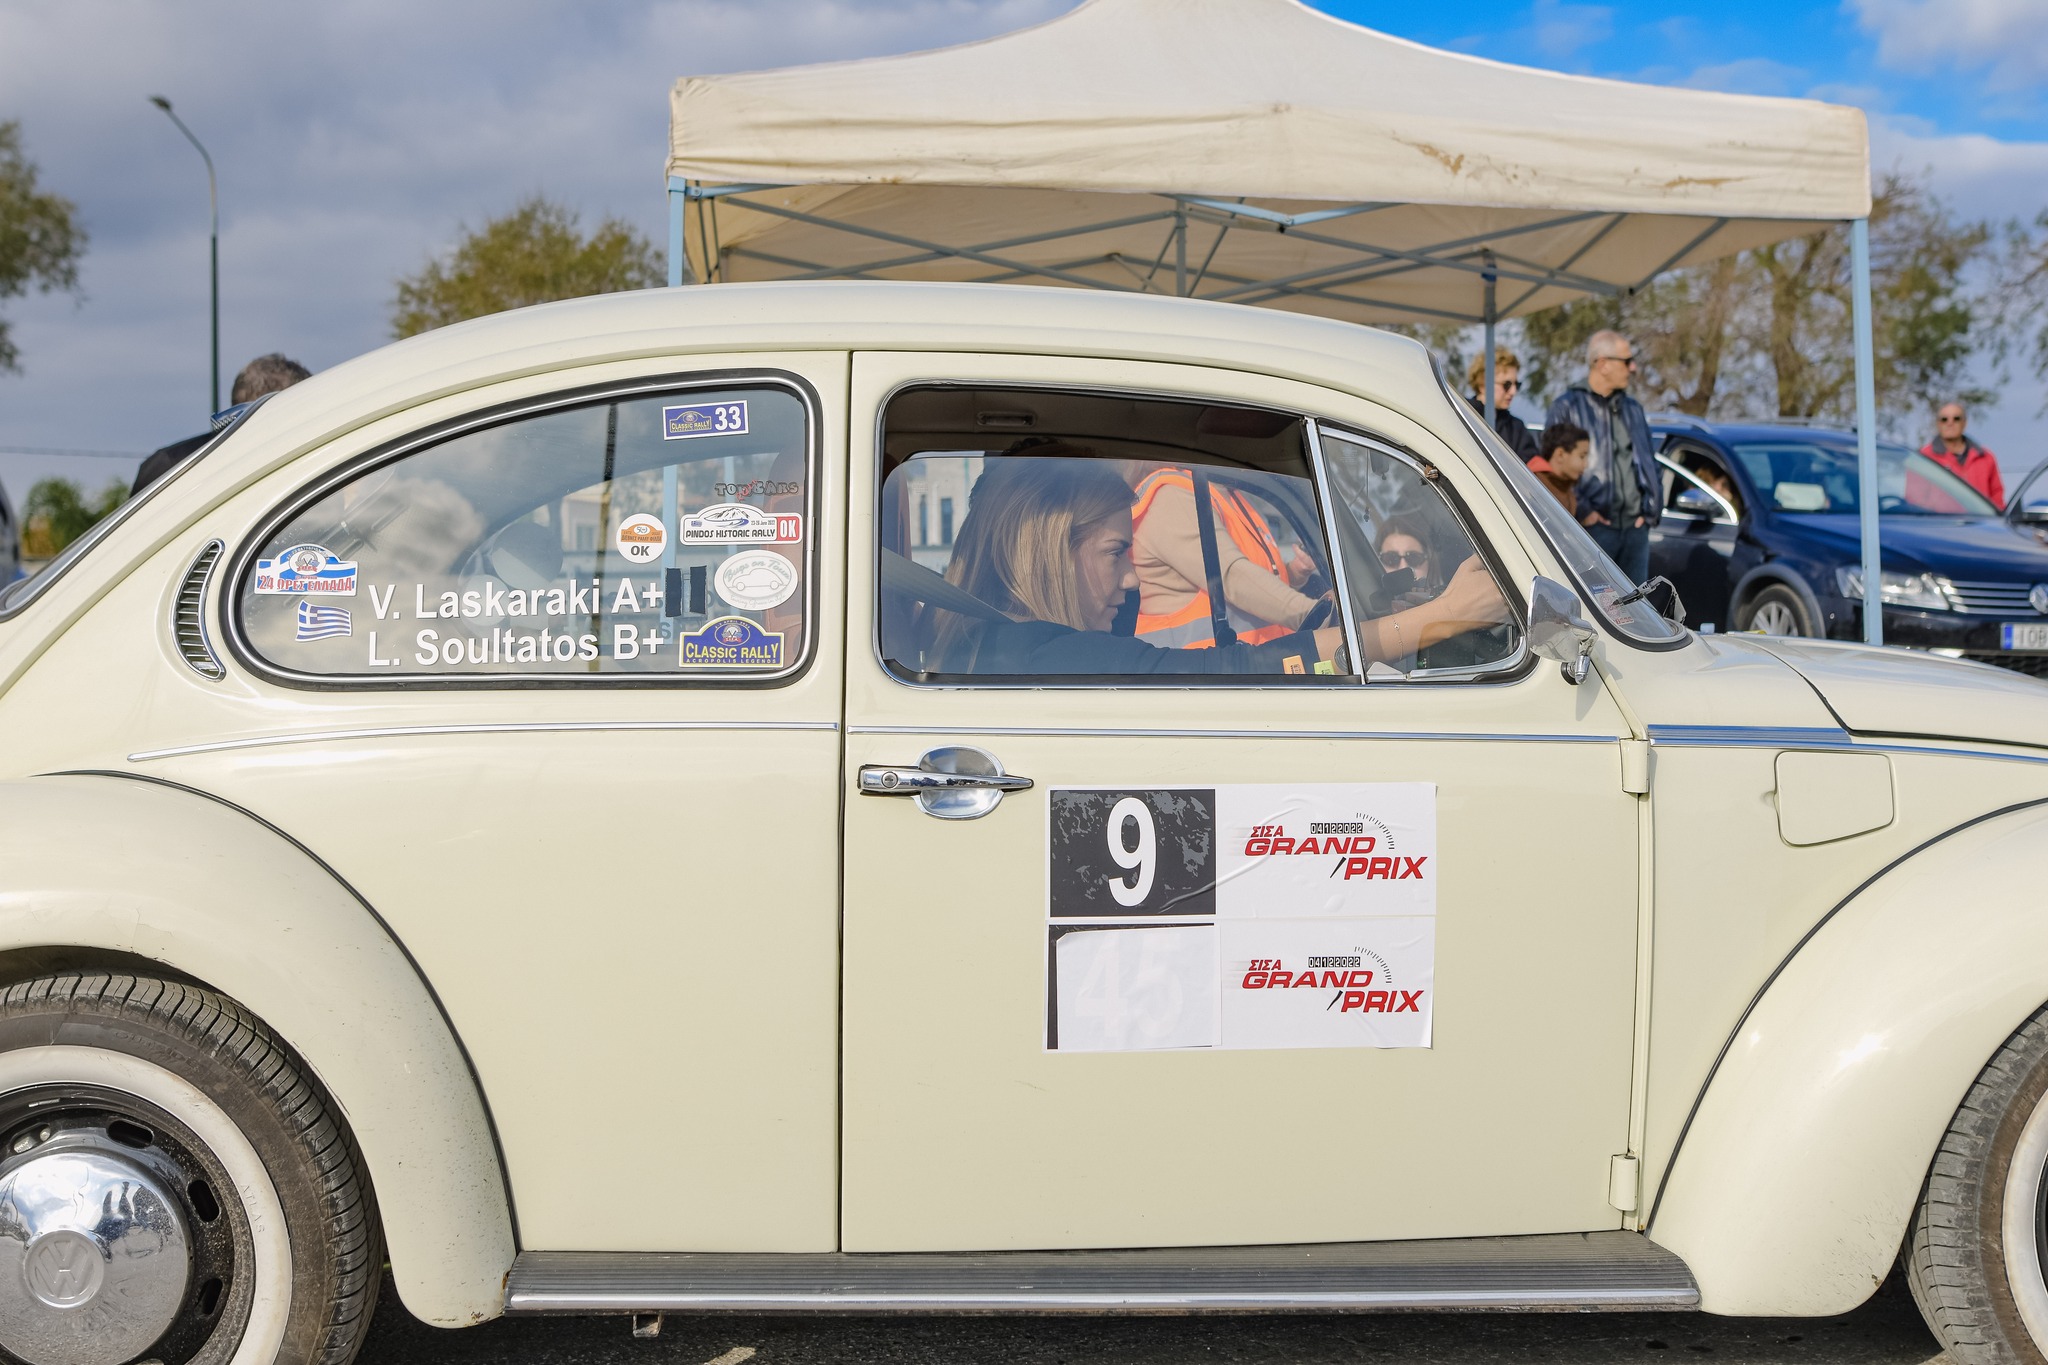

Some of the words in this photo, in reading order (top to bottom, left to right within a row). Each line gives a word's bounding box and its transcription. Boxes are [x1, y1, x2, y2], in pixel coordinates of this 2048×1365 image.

[694, 419, 710, 429] RALLY
[715, 406, 742, 431] 33
[686, 529, 714, 539] PINDOS
[716, 529, 750, 538] HISTORIC
[752, 529, 776, 538] RALLY
[780, 520, 797, 538] OK
[631, 545, 650, 556] OK
[724, 563, 750, 582] Bugs
[259, 575, 274, 590] 24
[277, 579, 305, 591] ΩΡΕΣ
[307, 577, 353, 591] ΕΛΛΑΔΑ
[368, 584, 400, 620] V.
[416, 578, 600, 619] Laskaraki
[610, 577, 664, 614] A+
[369, 631, 401, 666] L.
[415, 627, 599, 665] Soultatos
[614, 624, 665, 660] B+
[686, 642, 737, 659] CLASSIC
[741, 642, 779, 658] RALLY
[1250, 825, 1284, 838] ΣΙΣΑ
[1310, 822, 1364, 834] 04122022
[1107, 796, 1157, 907] 9
[1243, 836, 1377, 857] GRAND
[1343, 856, 1428, 880] PRIX
[1248, 959, 1282, 971] ΣΙΣΑ
[1308, 956, 1361, 968] 04122022
[1241, 970, 1374, 989] GRAND
[1340, 990, 1424, 1013] PRIX
